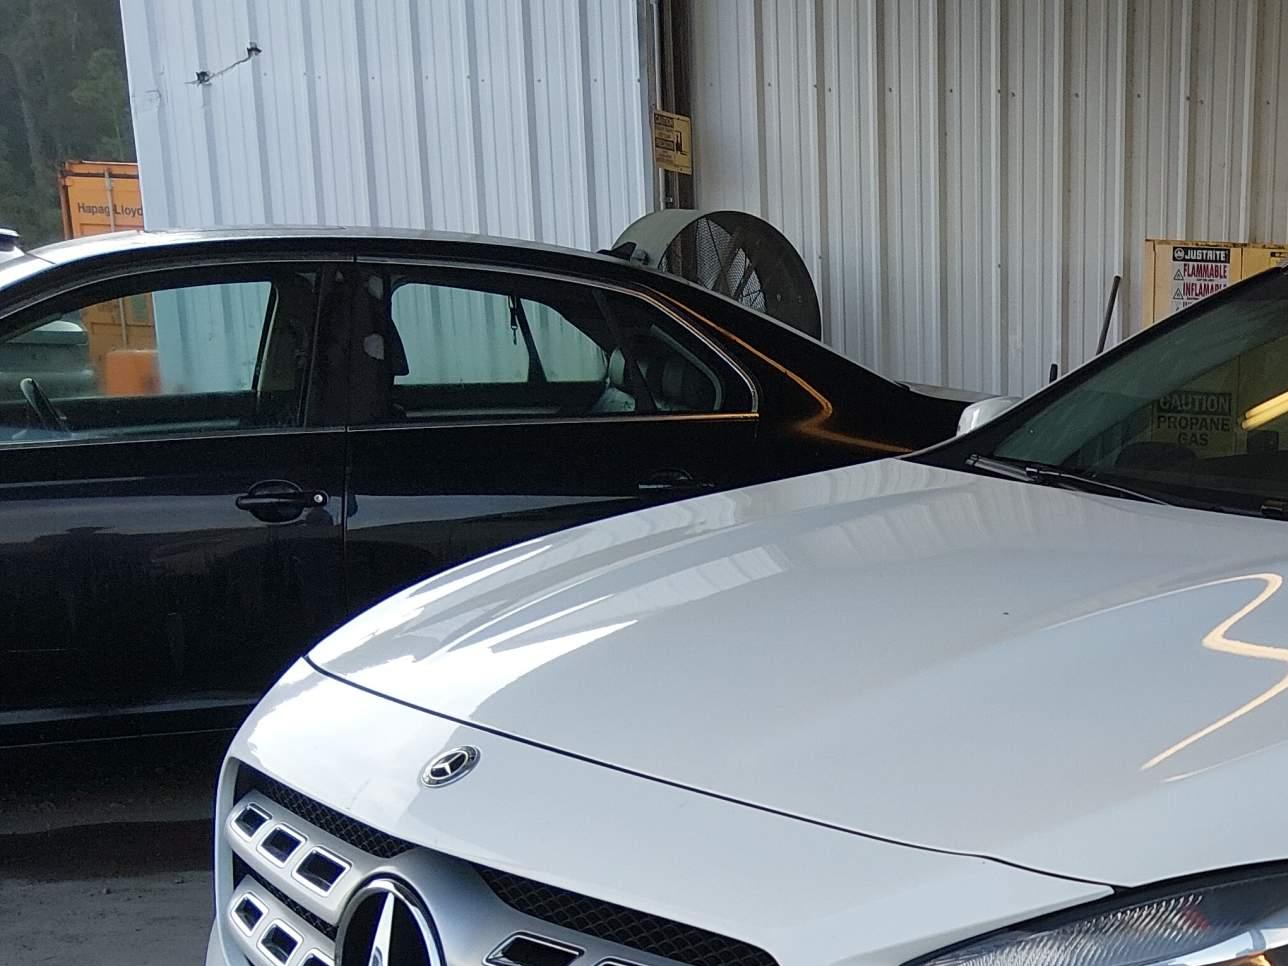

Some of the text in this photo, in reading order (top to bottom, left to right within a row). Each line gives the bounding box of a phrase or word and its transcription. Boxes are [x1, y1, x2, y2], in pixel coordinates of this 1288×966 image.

[1184, 248, 1227, 260] JUSTRITE
[1183, 263, 1227, 279] FLAMMABLE
[1160, 393, 1231, 412] CAUTION
[1157, 415, 1231, 432] PROPANE
[1178, 431, 1209, 446] GAS
